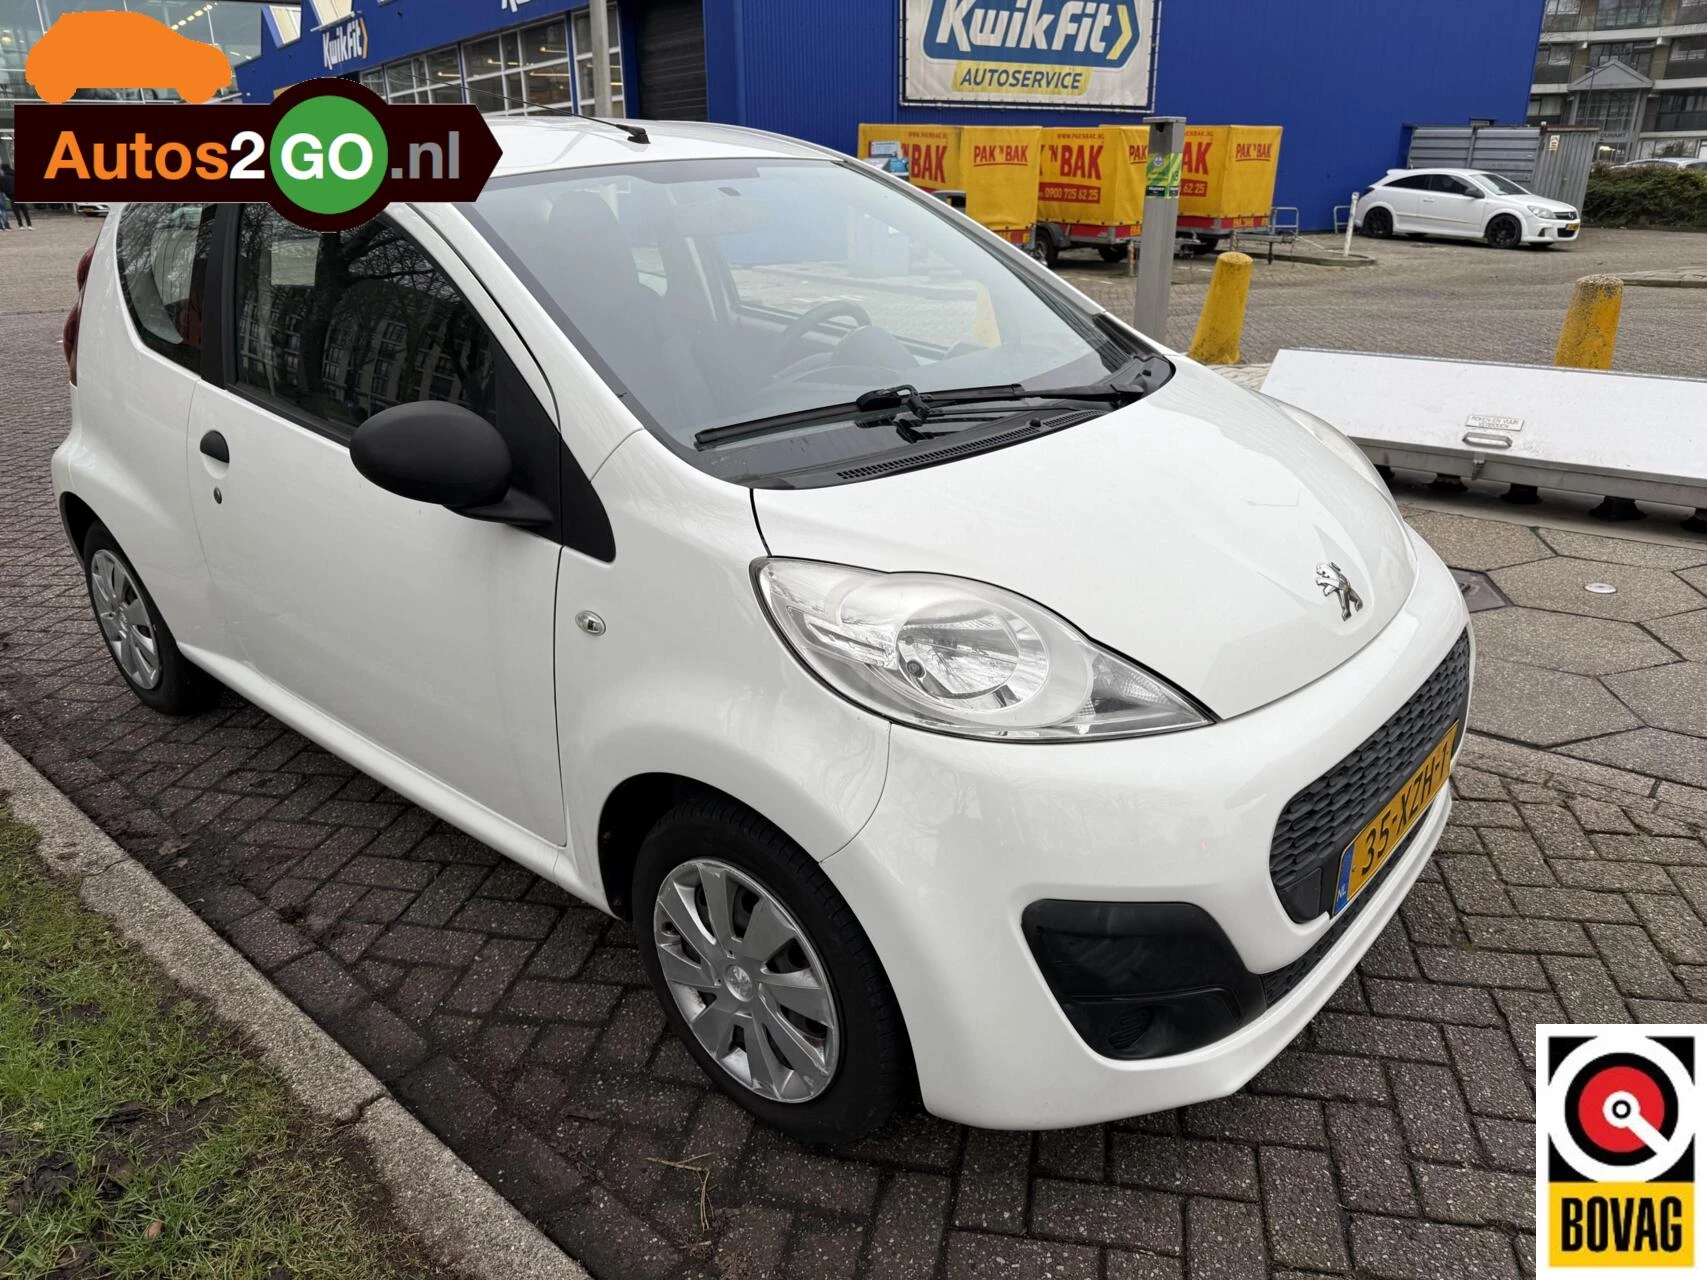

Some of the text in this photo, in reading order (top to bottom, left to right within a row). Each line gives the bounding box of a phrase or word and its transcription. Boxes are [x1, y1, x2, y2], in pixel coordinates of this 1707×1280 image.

[960, 67, 1083, 91] AUTOSERVICE
[974, 145, 997, 163] PAK
[1006, 144, 1029, 163] BAK
[1128, 144, 1148, 161] PAK
[1182, 141, 1212, 175] AK
[1236, 143, 1251, 159] PAK
[1257, 143, 1272, 159] BAK
[911, 143, 948, 184] BAK
[1060, 144, 1104, 180] BAK
[1044, 187, 1062, 199] 0900
[1063, 187, 1077, 200] 725
[1078, 188, 1087, 200] 62
[1088, 189, 1099, 201] 25
[1182, 182, 1205, 195] 62 25
